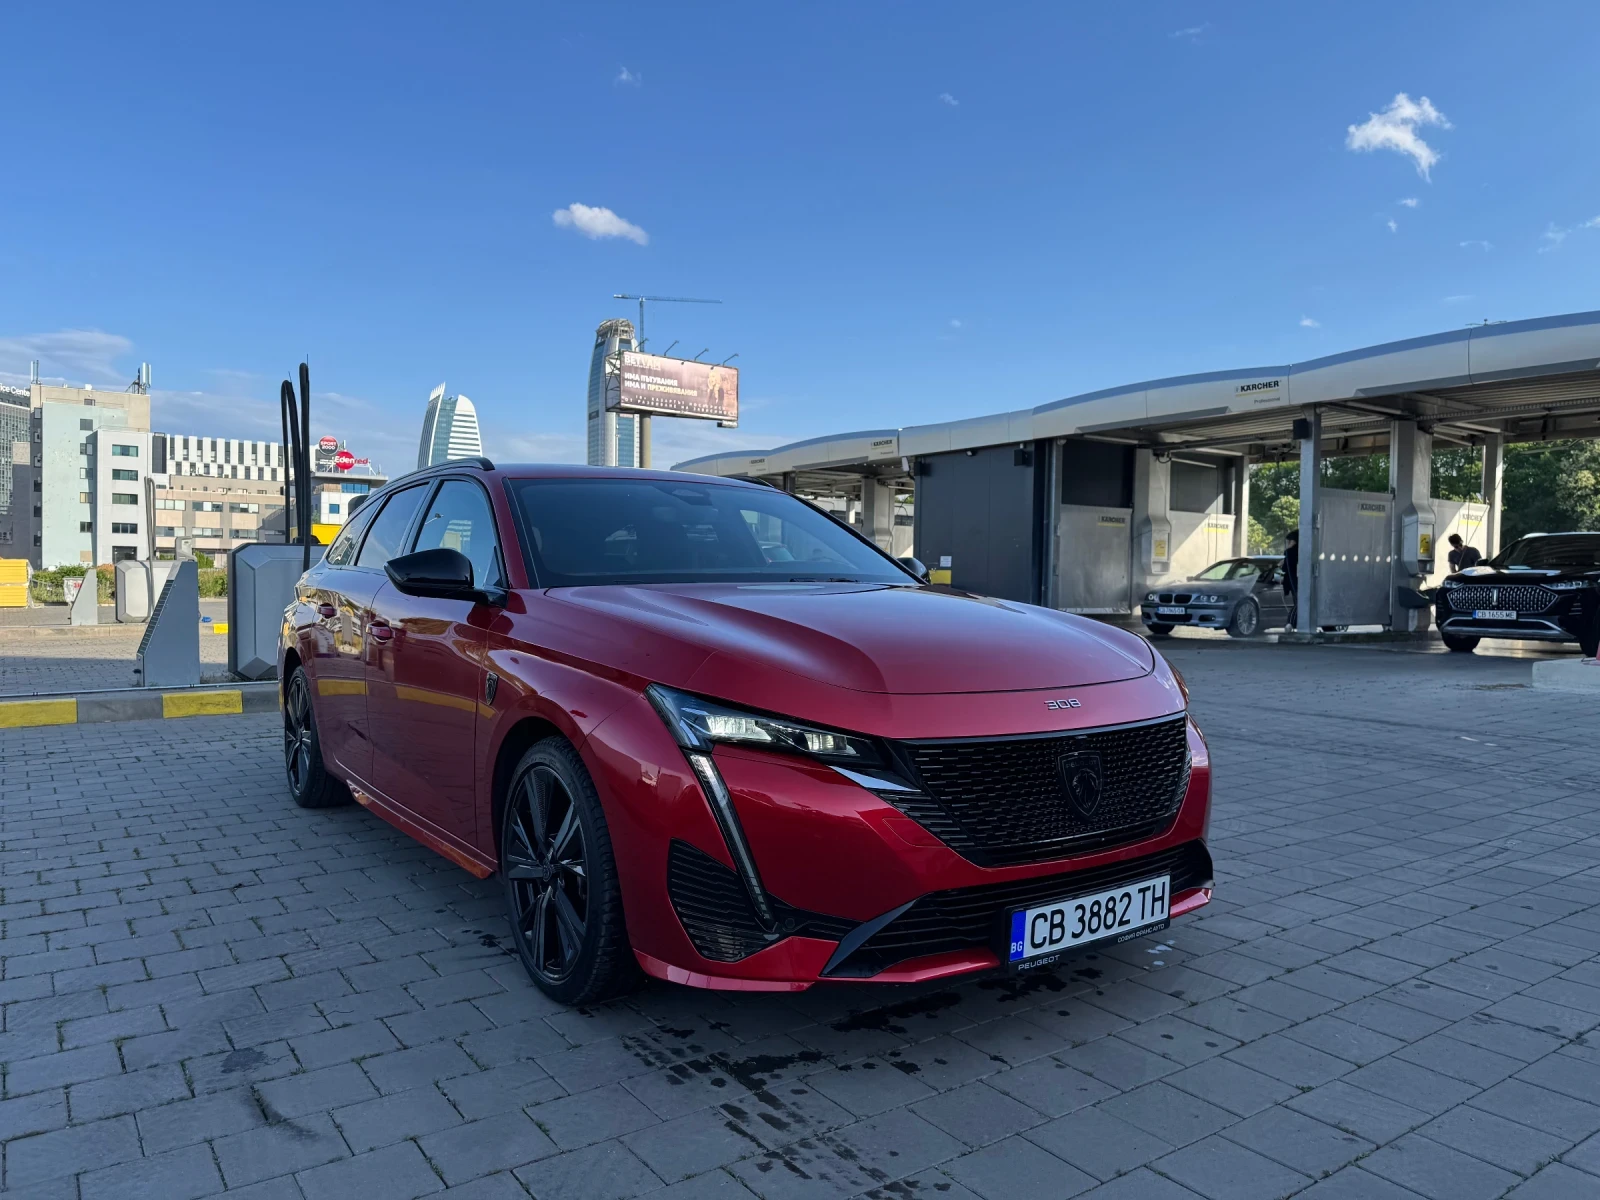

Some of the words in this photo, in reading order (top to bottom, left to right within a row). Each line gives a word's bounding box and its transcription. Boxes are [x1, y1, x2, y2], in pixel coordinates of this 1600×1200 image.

[624, 372, 640, 381] ИМА
[641, 375, 678, 386] ПЪТУВАНИЯ
[0, 383, 10, 392] ice
[624, 380, 640, 388] ИМА
[647, 384, 698, 397] ПРЕЖИВЯВАНИЯ
[335, 456, 369, 465] Edenred
[1488, 611, 1504, 619] 1655
[1043, 698, 1082, 711] 308
[1030, 908, 1066, 950] CB
[1071, 891, 1132, 939] 3882
[1137, 881, 1166, 921] TH
[1010, 941, 1024, 954] BG
[1018, 954, 1061, 971] PEUGEOT
